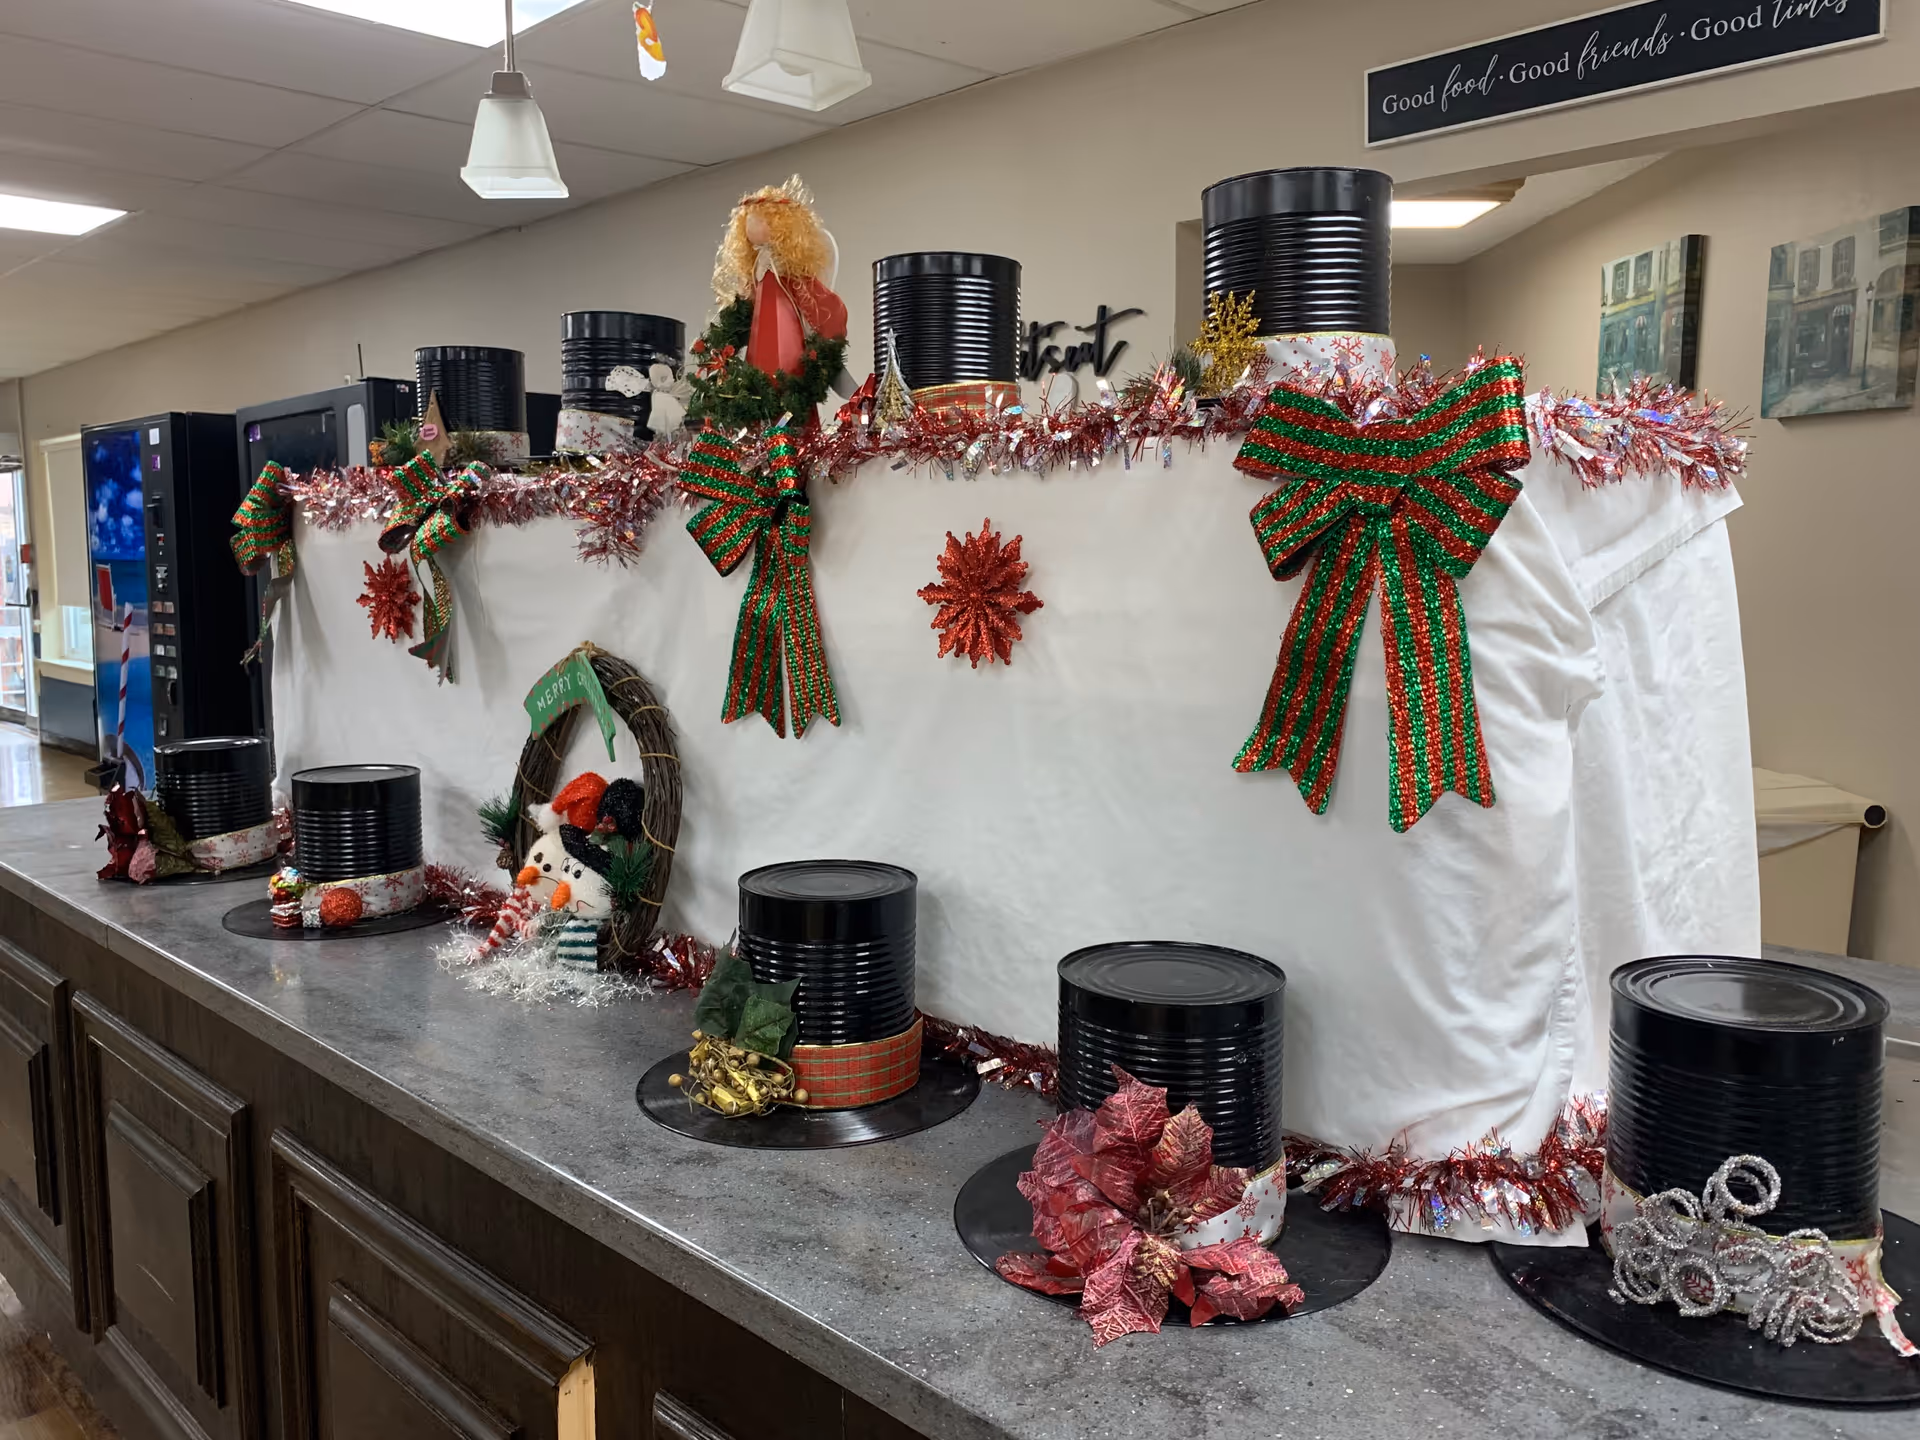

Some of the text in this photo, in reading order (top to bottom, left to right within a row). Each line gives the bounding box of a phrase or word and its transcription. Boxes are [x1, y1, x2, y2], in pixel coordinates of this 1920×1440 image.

[1382, 85, 1436, 115] Good
[1440, 54, 1498, 112] food
[1509, 51, 1570, 84] Good
[1577, 12, 1674, 80] friends
[1690, 4, 1763, 41] Good
[536, 673, 572, 712] MERRY
